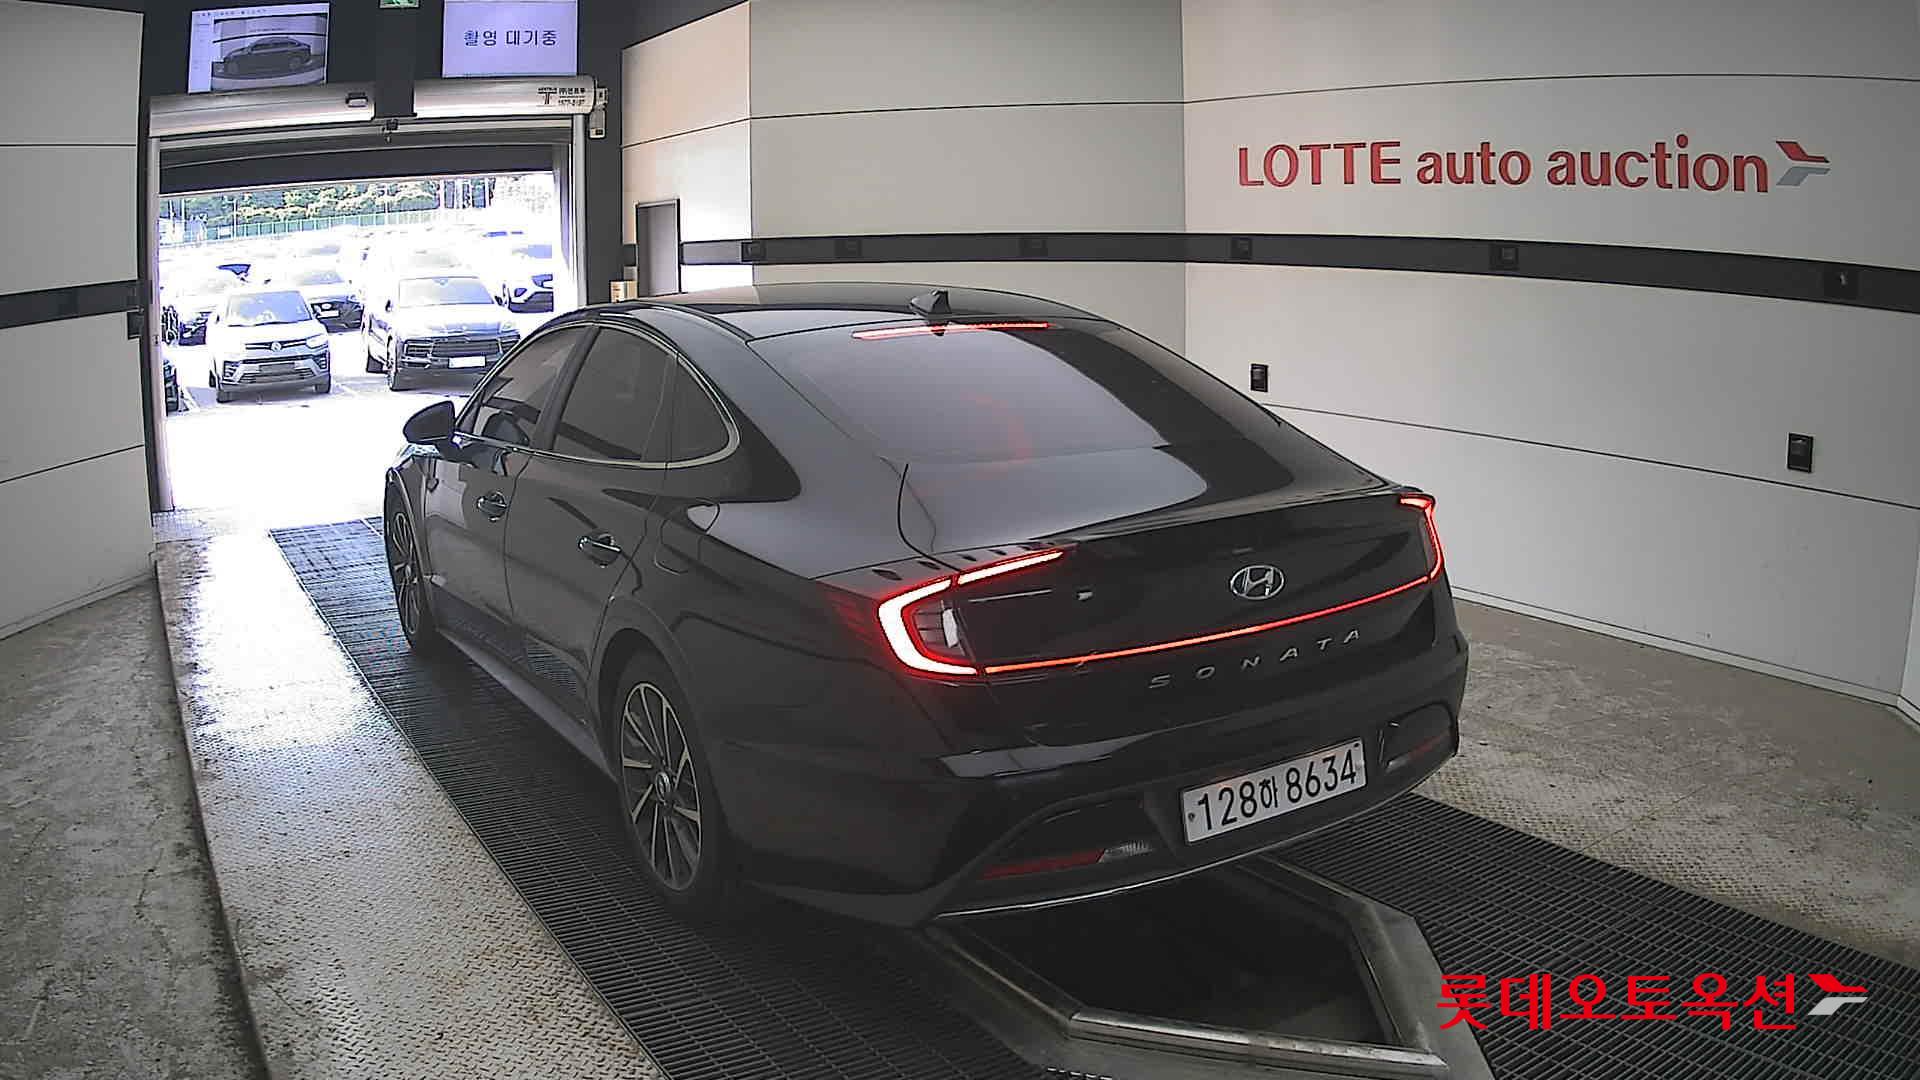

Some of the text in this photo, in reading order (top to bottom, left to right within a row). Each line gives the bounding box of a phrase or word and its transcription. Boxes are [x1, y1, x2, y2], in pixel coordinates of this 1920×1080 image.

[463, 30, 557, 47] 촬영 대기중
[1239, 135, 1769, 193] LOTTE auto auction
[1149, 630, 1360, 688] SONATA
[1285, 749, 1357, 804] 8634
